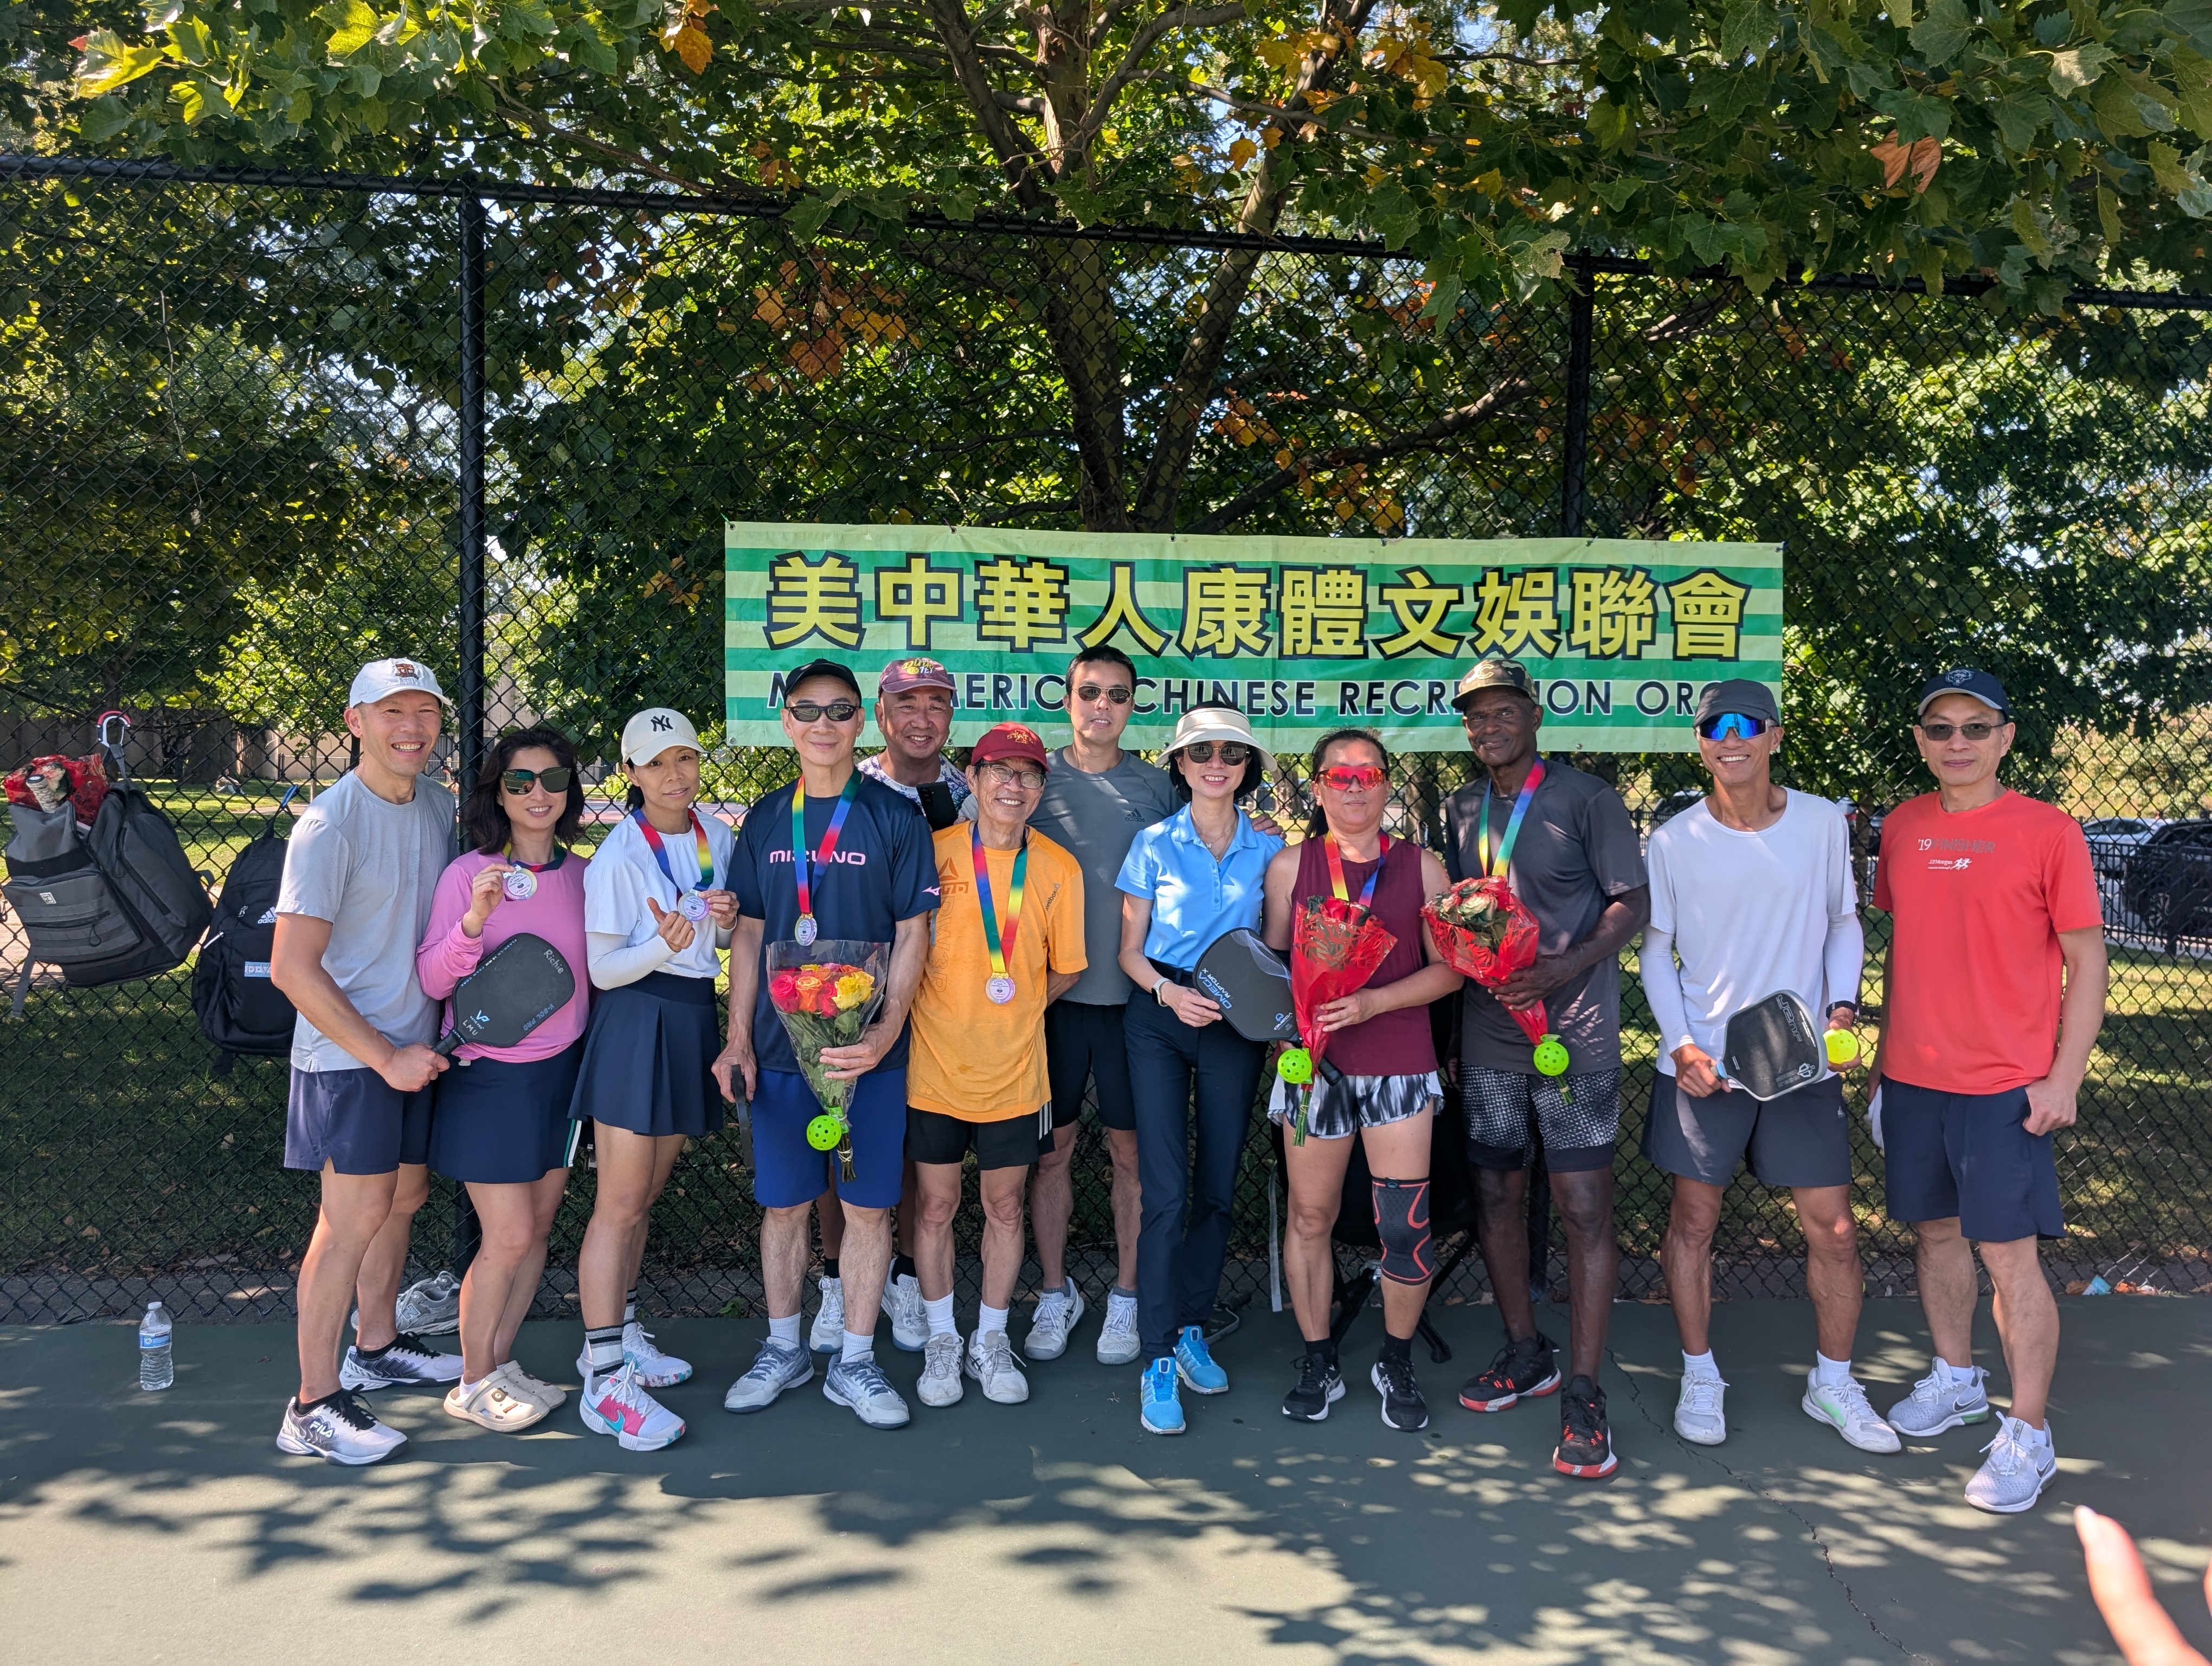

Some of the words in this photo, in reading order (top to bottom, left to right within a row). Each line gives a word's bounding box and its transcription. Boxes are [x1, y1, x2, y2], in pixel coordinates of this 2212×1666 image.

[762, 550, 1752, 662] 美中華人康體文娛聯會
[1477, 664, 1495, 680] C
[1134, 677, 1316, 716] CHINESE
[1635, 679, 1723, 717] OR
[650, 715, 673, 732] NY
[769, 850, 866, 866] MINO
[543, 949, 564, 974] Richie
[1198, 971, 1232, 1009] OMEGA
[1207, 974, 1231, 998] RAPTOR
[462, 1020, 478, 1036] LMU
[309, 1421, 333, 1438] FILA
